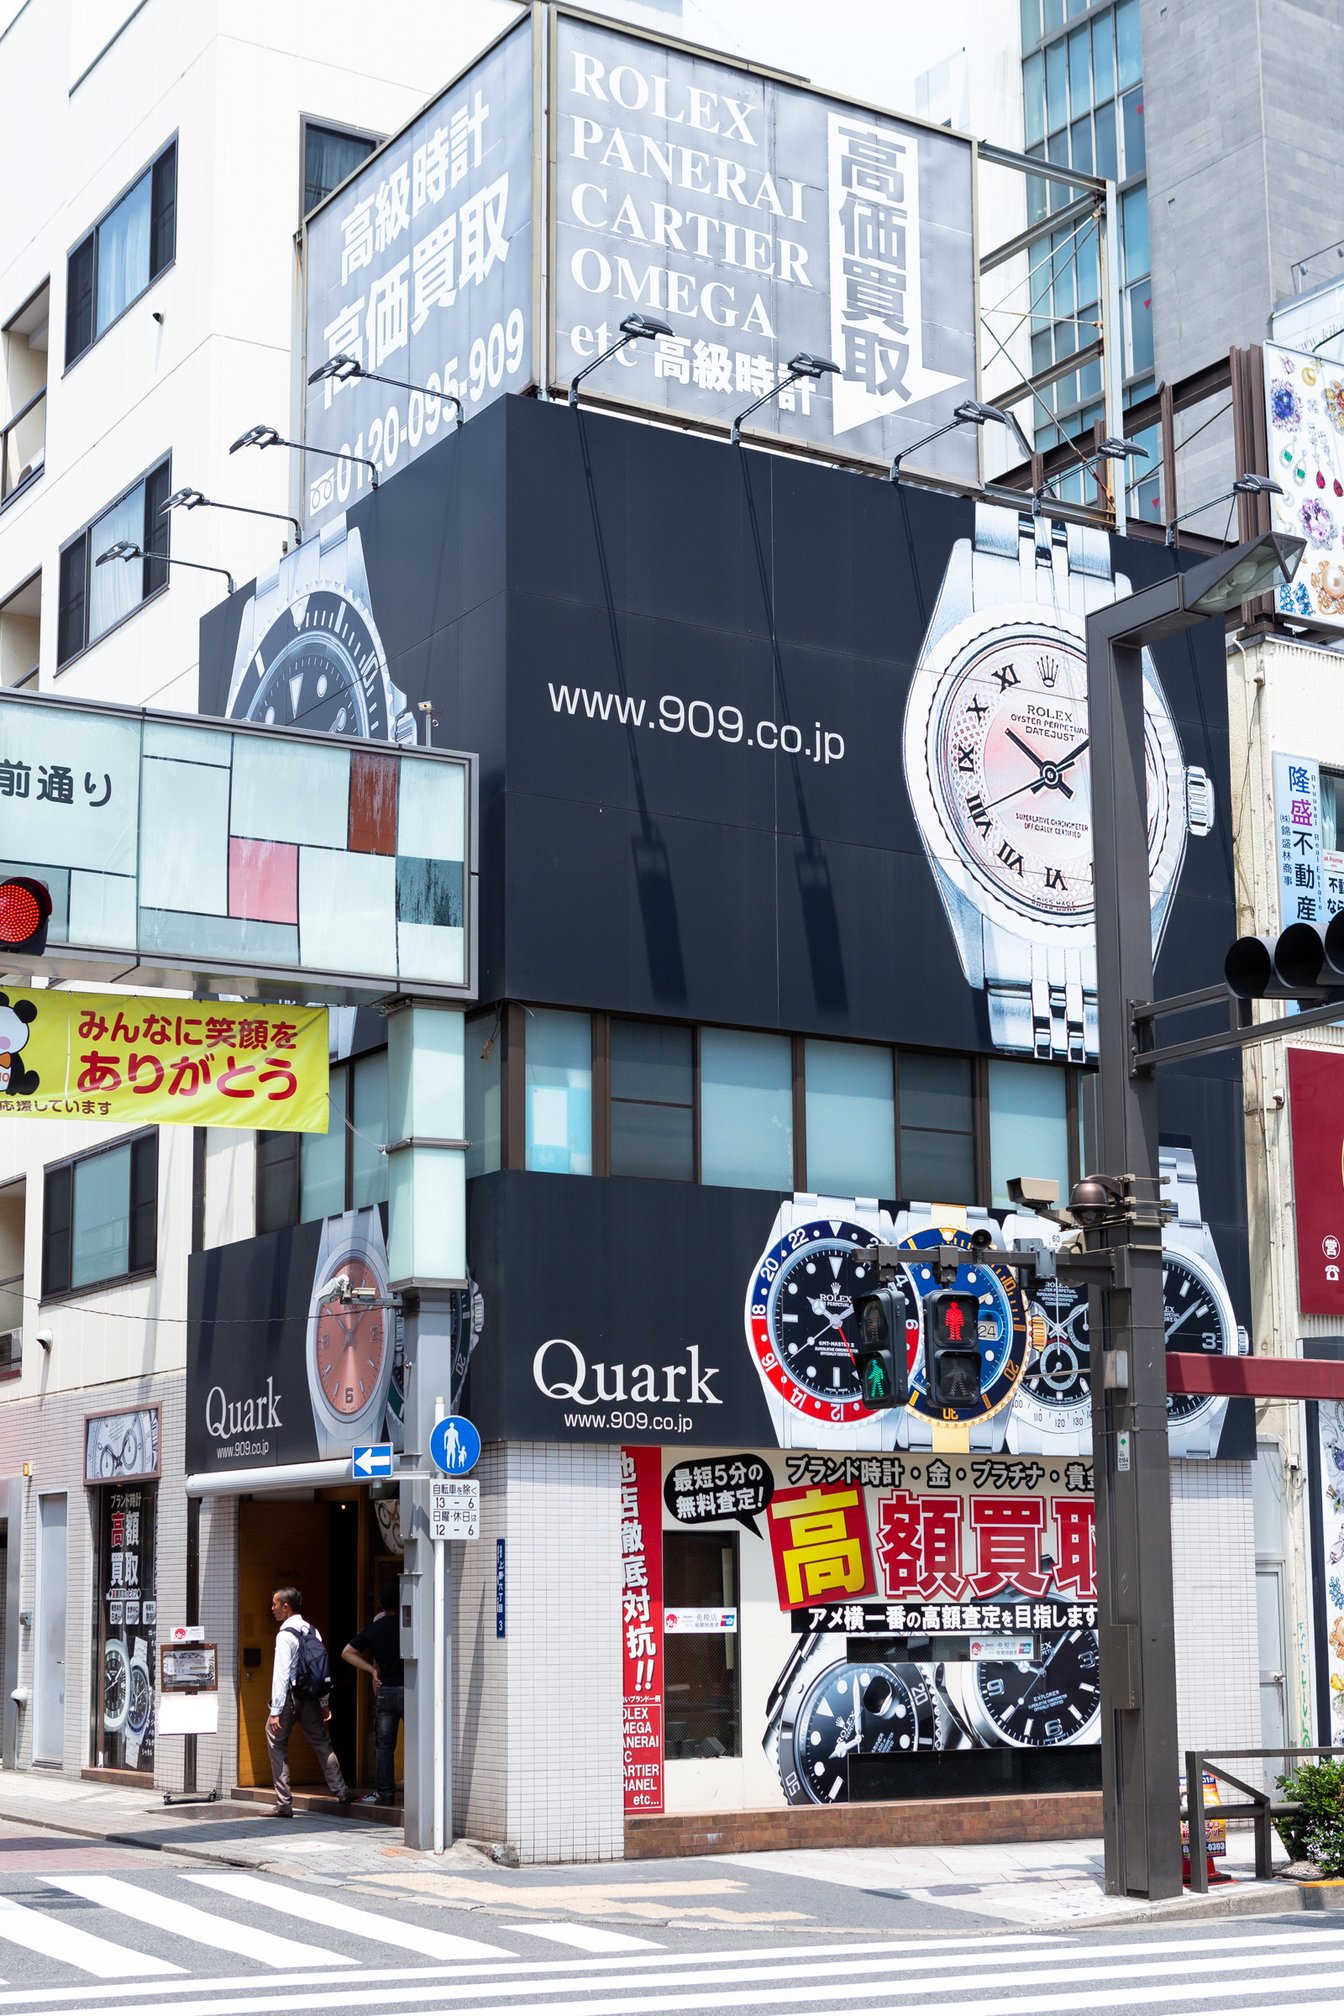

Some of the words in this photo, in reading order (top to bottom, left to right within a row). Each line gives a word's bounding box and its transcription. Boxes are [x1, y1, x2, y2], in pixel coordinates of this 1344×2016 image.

[569, 50, 759, 147] ROLEX
[569, 114, 809, 225] PANERAI
[340, 89, 490, 287] 高級時計
[569, 182, 813, 288] CARTIER
[836, 125, 914, 403] 高価買取
[322, 171, 511, 409] 高価買取
[570, 247, 777, 340] OMEGA
[570, 320, 638, 368] etc
[653, 332, 818, 416] 高級時計
[547, 682, 846, 764] www.909.co.jp
[1010, 713, 1042, 726] OYSTER
[1027, 704, 1073, 723] ROLEX
[1025, 725, 1076, 742] DATEJUST
[0, 758, 112, 807] 前通り
[1288, 765, 1317, 922] 隆盛不動産
[77, 1010, 298, 1051] みんなに笑顔を
[76, 1050, 298, 1100] ありがとう
[0, 1099, 112, 1116] 応援しています
[788, 1228, 810, 1250] 22
[760, 1256, 779, 1282] 20
[819, 1293, 853, 1303] ROLEX
[752, 1303, 767, 1320] 18
[978, 1325, 997, 1338] 24
[1201, 1332, 1217, 1350] 3
[532, 1338, 724, 1406] Quark
[1004, 1359, 1020, 1382] 20
[205, 1376, 283, 1439] Quark
[564, 1411, 693, 1433] www.909.co.jp
[1055, 1419, 1065, 1428] 120
[216, 1440, 269, 1459] www.909.co.jp
[672, 1462, 763, 1493] 最短5分の
[111, 1491, 142, 1509] ブランド時計
[432, 1483, 477, 1496] 自転車を除く
[435, 1497, 446, 1508] 13
[468, 1497, 475, 1508] 6
[675, 1486, 764, 1519] 無料査定!
[111, 1511, 140, 1547] 高額
[435, 1524, 446, 1536] 12
[468, 1524, 475, 1536] 6
[111, 1552, 139, 1586] 買取
[807, 1605, 1097, 1631] アメ横一番の高額査定を目指します
[1078, 1650, 1096, 1669] 3
[911, 1682, 929, 1707] 20
[986, 1678, 1006, 1697] 9
[623, 1695, 661, 1703] いブランド一例
[623, 1707, 649, 1720] OLEX
[623, 1721, 653, 1735] MEGA
[1044, 1718, 1064, 1737] 6
[623, 1735, 660, 1748] ANERAI
[623, 1764, 660, 1777] ARTIER
[623, 1779, 658, 1791] HANEL
[785, 1771, 801, 1797] 50
